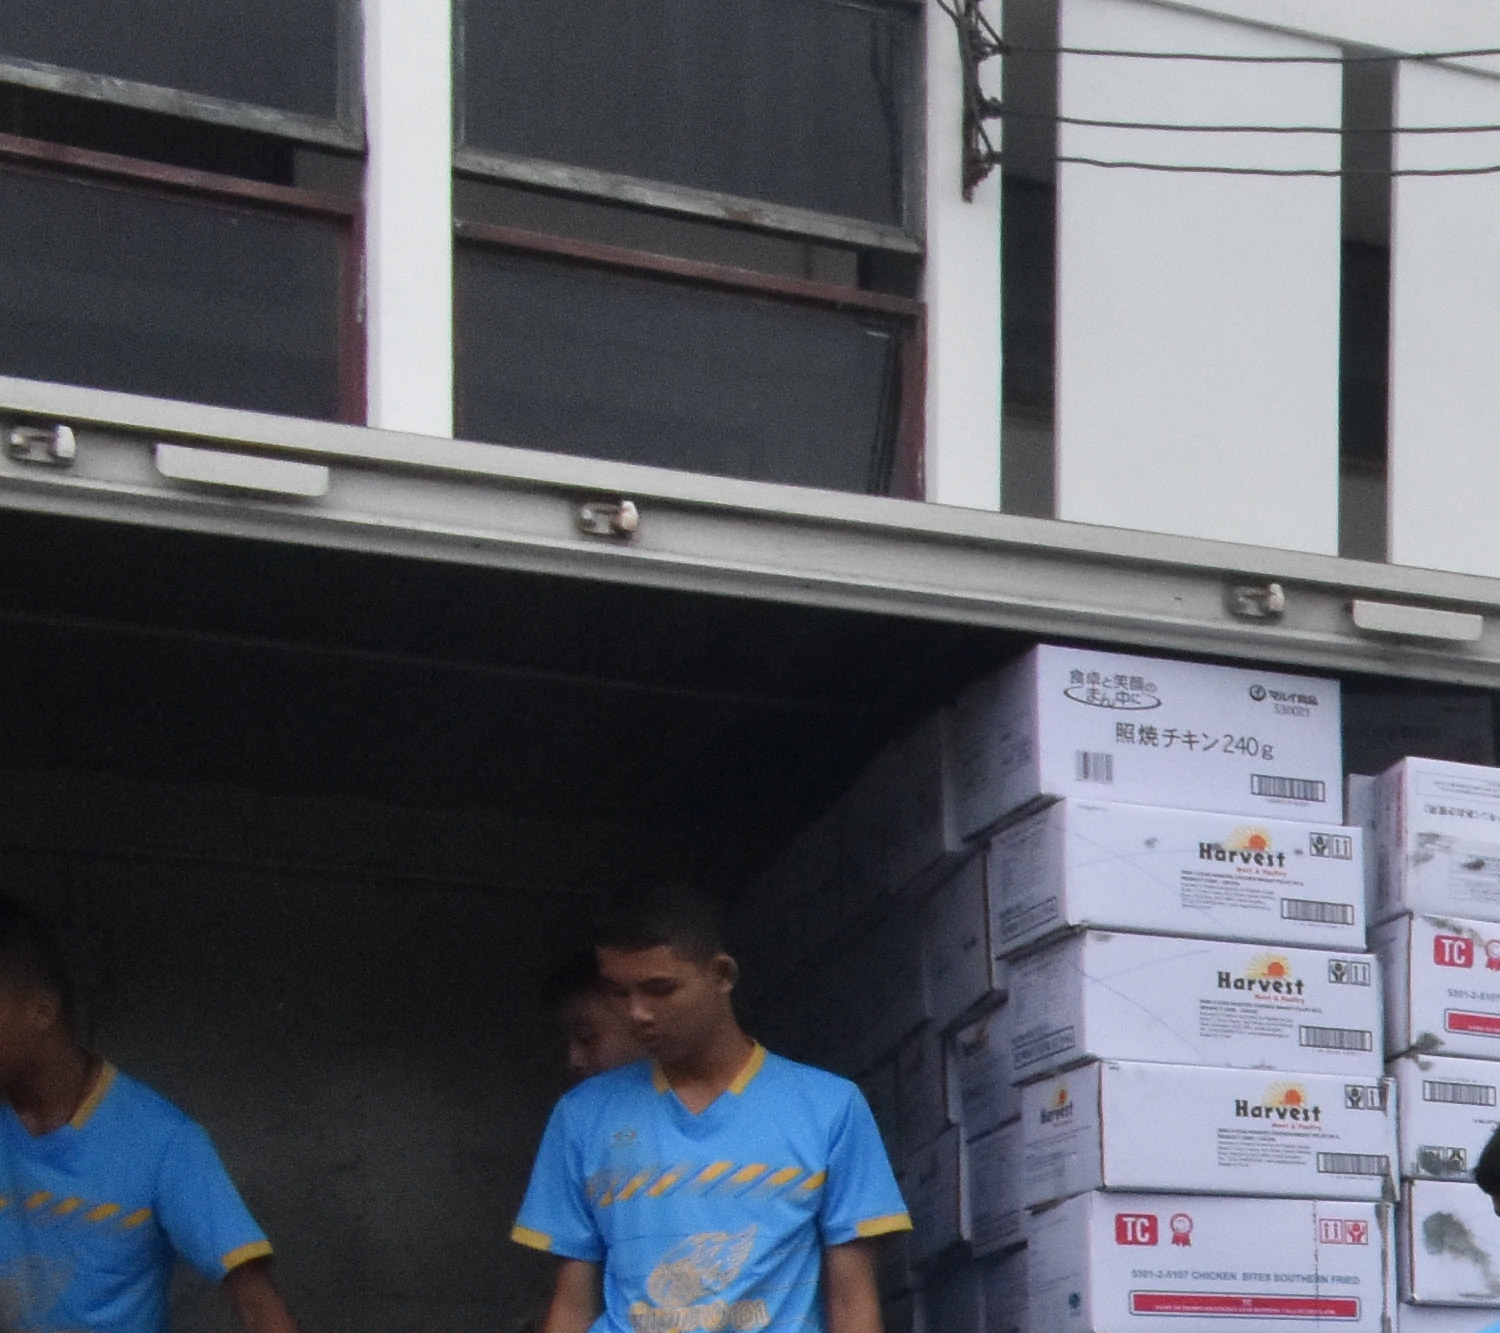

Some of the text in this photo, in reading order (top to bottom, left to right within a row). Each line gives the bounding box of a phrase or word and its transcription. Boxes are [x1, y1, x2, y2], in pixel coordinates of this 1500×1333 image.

[1199, 842, 1286, 868] Harvest
[1441, 939, 1466, 965] TC
[1217, 971, 1304, 995] Harvest
[1235, 1099, 1321, 1122] Harvest
[1123, 1218, 1150, 1243] TC
[1191, 1271, 1237, 1282] CHICKEN
